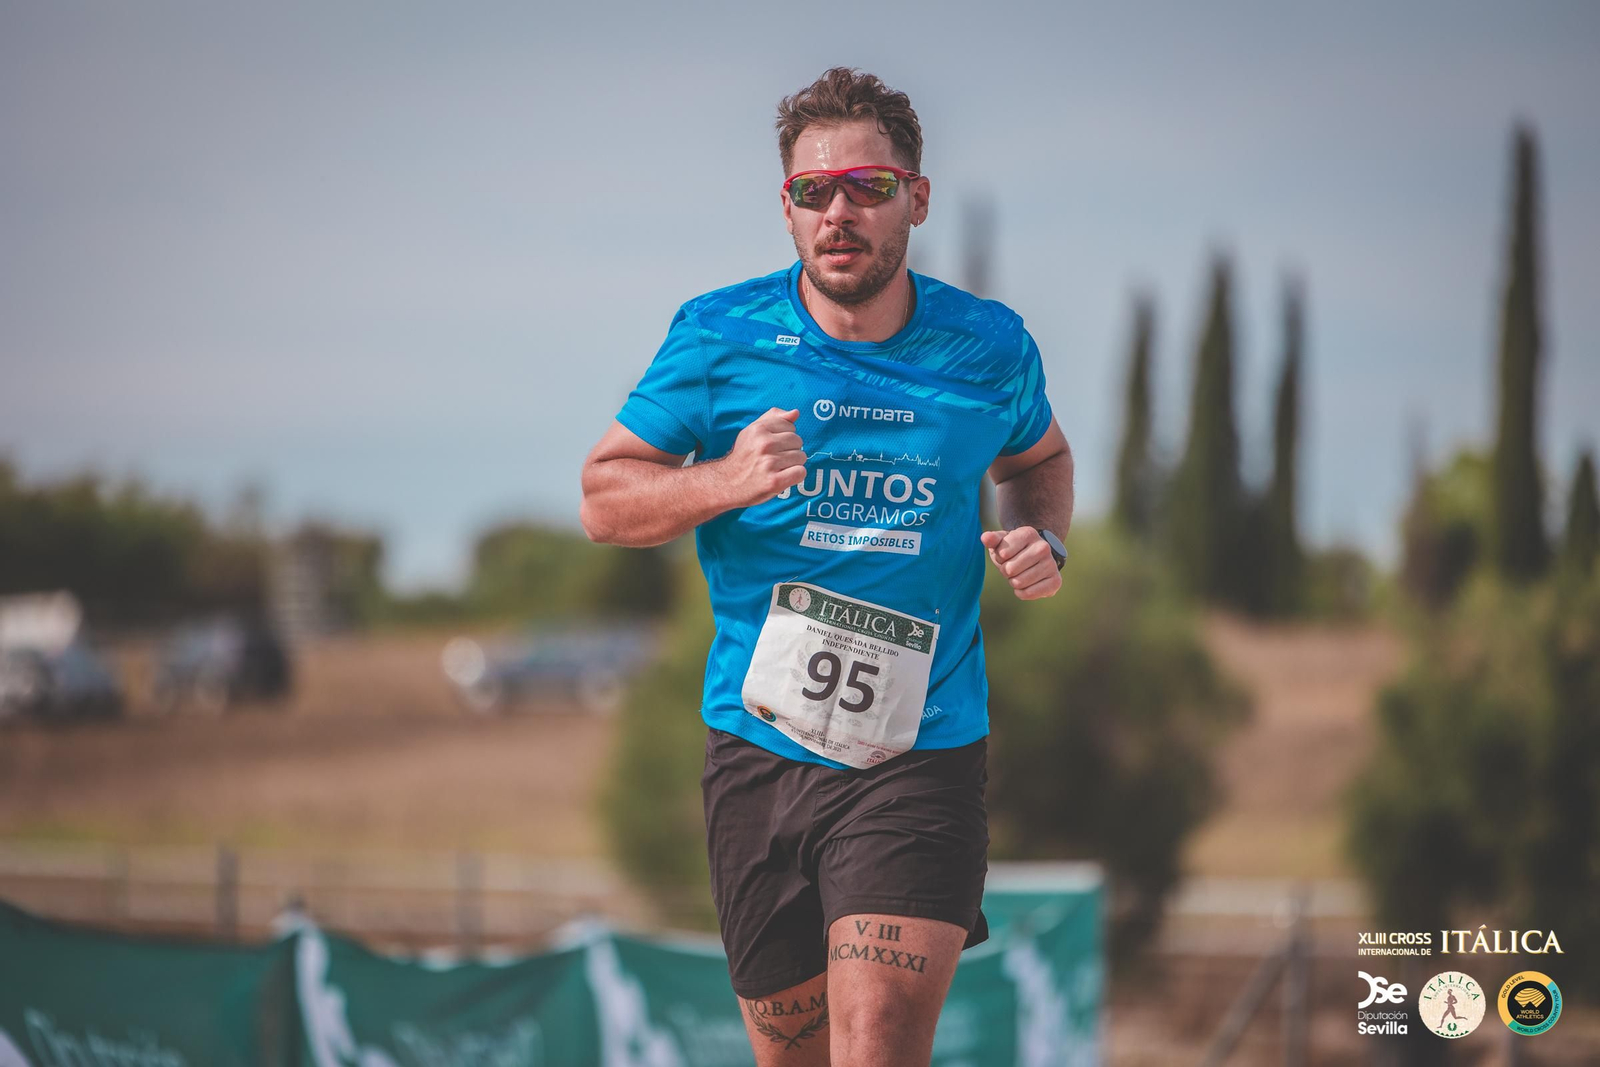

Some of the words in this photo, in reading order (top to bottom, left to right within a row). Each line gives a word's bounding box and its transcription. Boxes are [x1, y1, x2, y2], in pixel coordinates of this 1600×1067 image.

[839, 406, 871, 419] NTT
[806, 502, 930, 526] LOGRAMOS
[808, 531, 845, 545] RETOS
[848, 534, 915, 549] IMPOSIBLES
[819, 601, 896, 637] ITÁLICA
[806, 625, 833, 638] DANIEL
[833, 633, 868, 648] QUESADA
[869, 644, 899, 657] BELLIDO
[822, 639, 880, 660] INDEPENDIENTE
[801, 651, 880, 713] 95
[855, 920, 873, 937] V.
[878, 924, 903, 941] III
